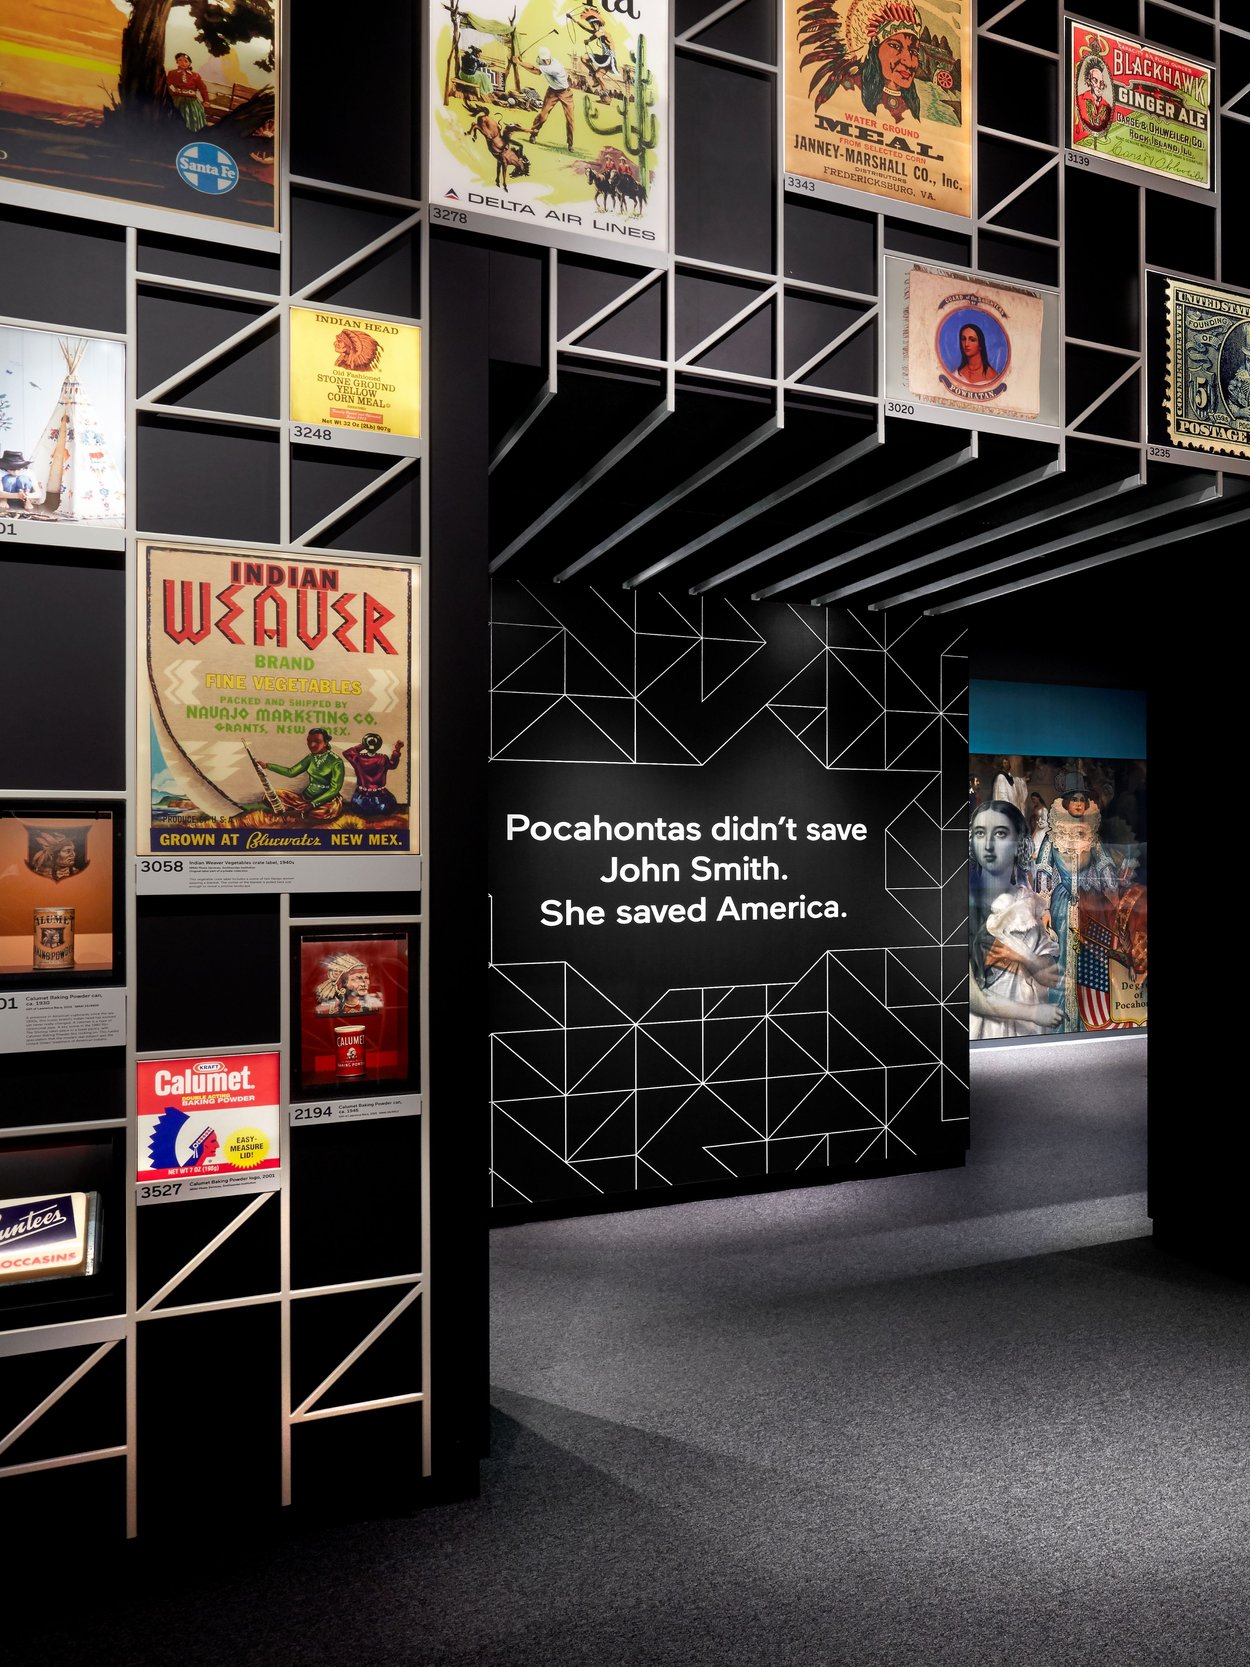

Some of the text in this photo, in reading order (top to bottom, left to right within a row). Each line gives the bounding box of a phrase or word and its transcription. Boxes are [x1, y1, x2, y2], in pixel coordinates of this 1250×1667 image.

[1113, 48, 1207, 108] BLACKHAWK
[1118, 86, 1206, 129] GINGER ALE
[844, 112, 920, 139] WATER GROUND
[1140, 121, 1147, 131] &
[1148, 122, 1190, 145] OHLWEILER
[814, 114, 944, 162] MEAL
[1129, 129, 1180, 154] ROCK ISLAND,
[839, 137, 927, 165] FROM SELECTED CORN
[1067, 152, 1090, 167] 3139
[179, 156, 236, 181] Santa Fe
[793, 134, 963, 191] JANNEY-MARSHALL CO., Inc.
[787, 176, 816, 192] 3343
[823, 166, 937, 201] FREDERICKSBURG, VA.
[855, 166, 907, 184] DISTRIBUTORS
[433, 207, 468, 224] 3278
[468, 192, 656, 241] DELTA AIR LINES
[1176, 290, 1221, 310] UNITED
[315, 314, 399, 335] INDIAN HEAD
[1188, 316, 1228, 329] FOUNDING
[1201, 335, 1214, 343] OF
[317, 373, 396, 393] STONE GROUND
[332, 369, 381, 382] Old Fashioned
[327, 392, 355, 405] CORN
[357, 396, 386, 409] MEAL
[336, 384, 378, 398] YELLOW
[1194, 377, 1209, 409] 5
[887, 402, 915, 415] 3020
[293, 425, 332, 441] 3248
[1179, 419, 1248, 444] POSTAGE
[1149, 447, 1171, 458] 3235
[230, 560, 339, 592] INDIAN
[162, 577, 399, 656] WEAVER
[254, 653, 315, 671] BRAND
[204, 673, 363, 696] FINE VEGETABLES
[219, 695, 347, 709] PACKED AND SHIPPED BY
[186, 704, 378, 726] NAVAJO MARKETING CO.
[214, 723, 351, 737] GRANTS, NEW MEX.
[506, 813, 868, 842] Pocahontas didn’t save
[159, 831, 403, 850] GROWN AT Bluewater NEW MEX.
[140, 860, 184, 873] 3058
[599, 855, 789, 884] John Smith.
[539, 893, 848, 928] She saved America.
[1134, 990, 1144, 999] of
[154, 1065, 251, 1096] Calumet
[181, 1095, 256, 1107] BAKING POWDER
[294, 1105, 333, 1120] 2194
[229, 1142, 264, 1152] MEASURE
[236, 1135, 257, 1144] EASY-
[239, 1151, 254, 1159] LID!
[167, 1167, 178, 1175] NET
[179, 1166, 189, 1174] WT
[189, 1166, 194, 1174] 7
[140, 1183, 183, 1199] 3527
[0, 1205, 66, 1240] untees
[0, 1252, 77, 1269] OCCASINS
